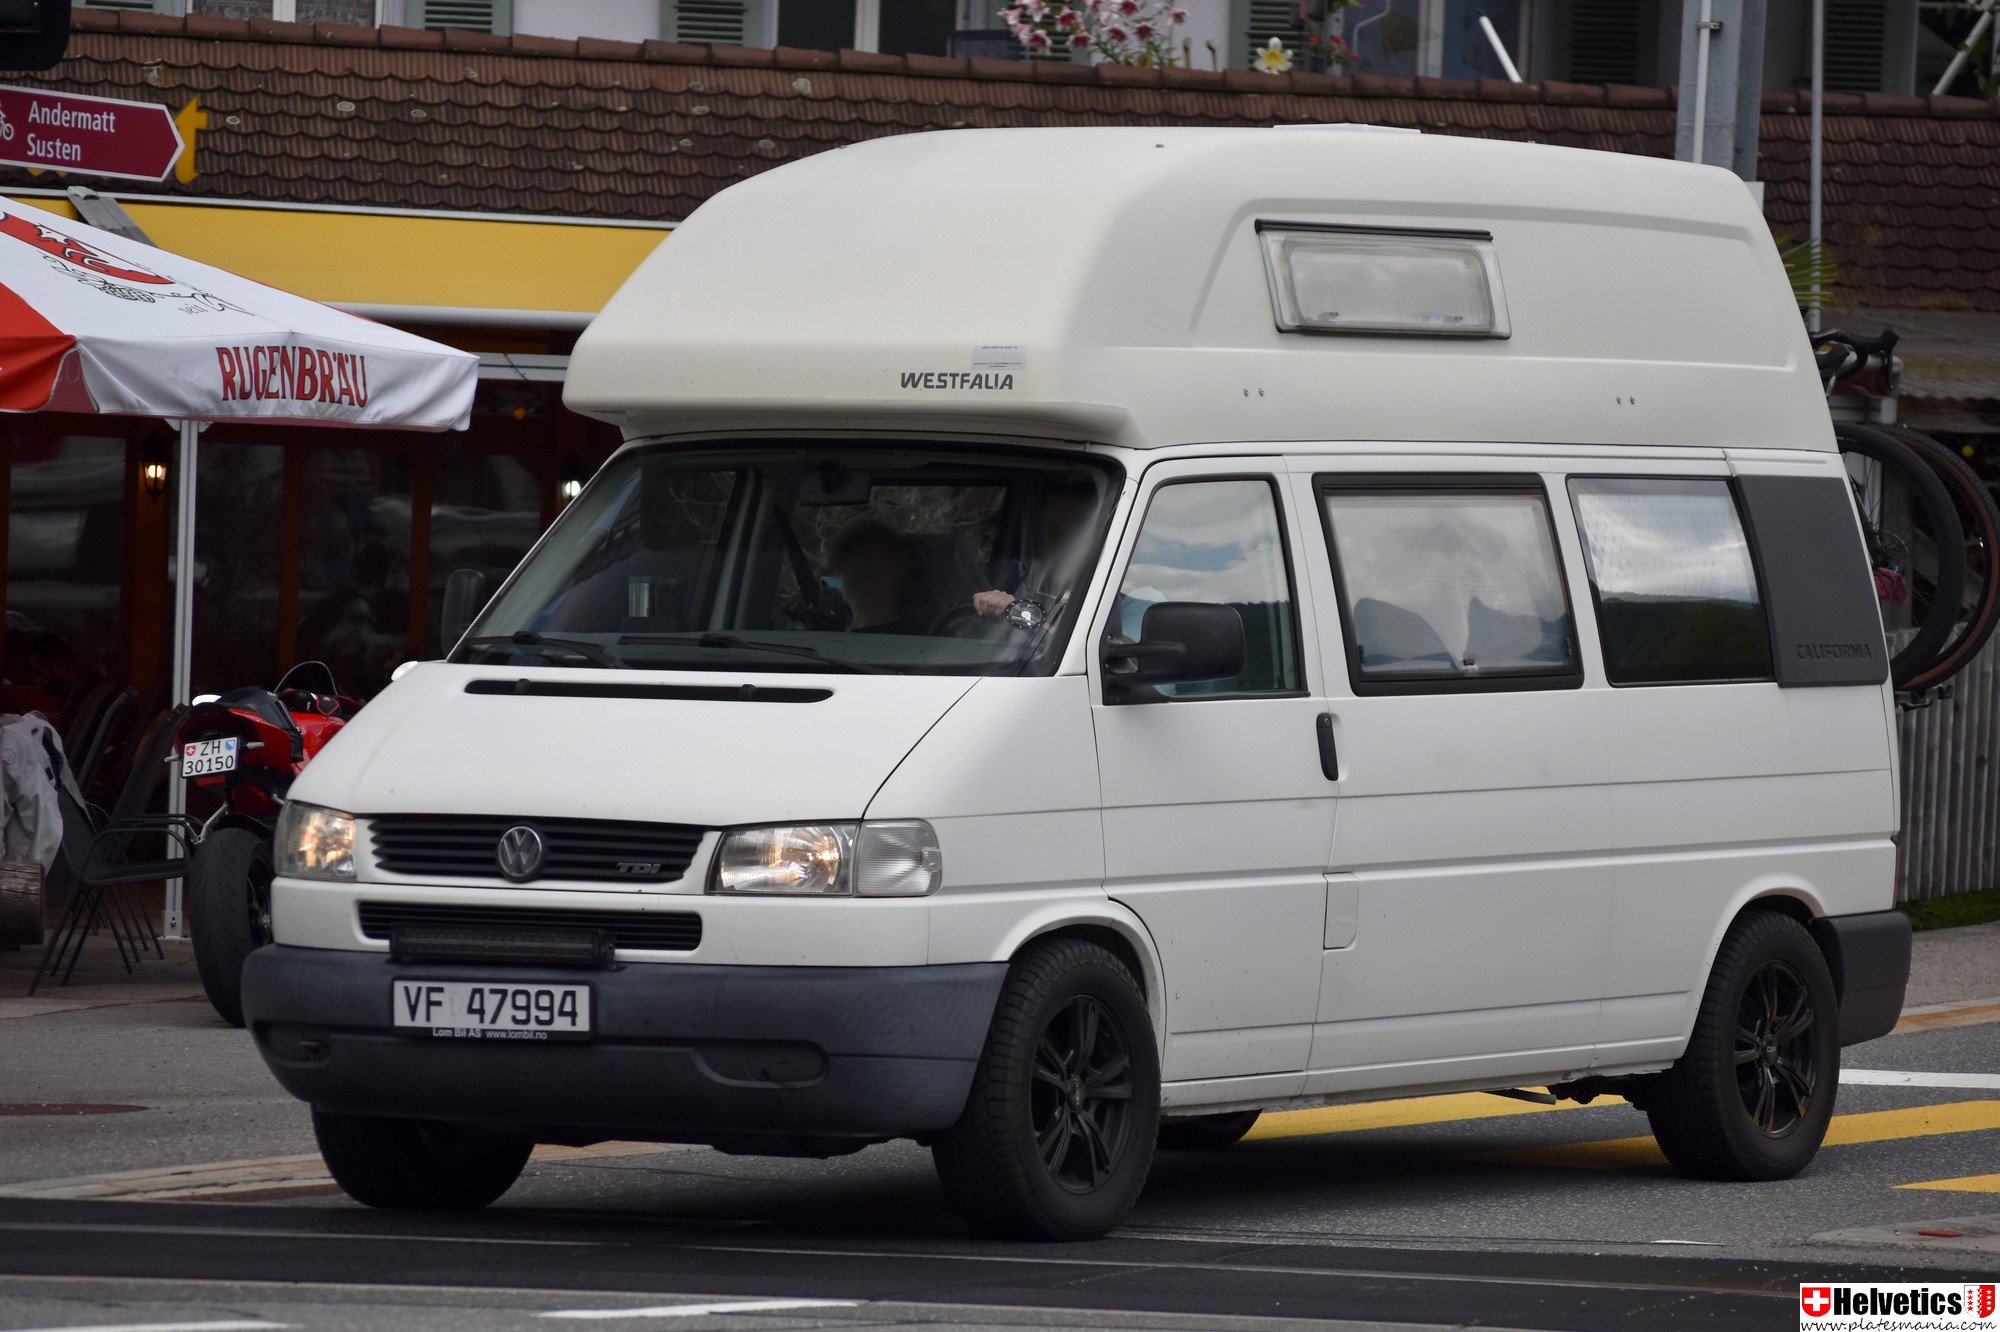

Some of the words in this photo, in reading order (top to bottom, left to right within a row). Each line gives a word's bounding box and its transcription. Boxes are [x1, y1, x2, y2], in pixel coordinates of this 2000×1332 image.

[28, 101, 116, 133] Andermatt
[27, 133, 81, 161] Susten
[216, 345, 369, 407] RUGENBRÄU
[900, 372, 1014, 390] WESTFALIA
[1796, 643, 1873, 660] CALIFORNIA
[200, 740, 221, 757] ZH
[185, 755, 234, 775] 30150
[616, 862, 661, 875] TDI
[403, 985, 445, 1022] VF
[467, 987, 578, 1027] 47994
[432, 1027, 452, 1037] Lom
[454, 1028, 466, 1038] Bil
[468, 1028, 481, 1038] AS
[485, 1029, 548, 1040] www.lombil.no
